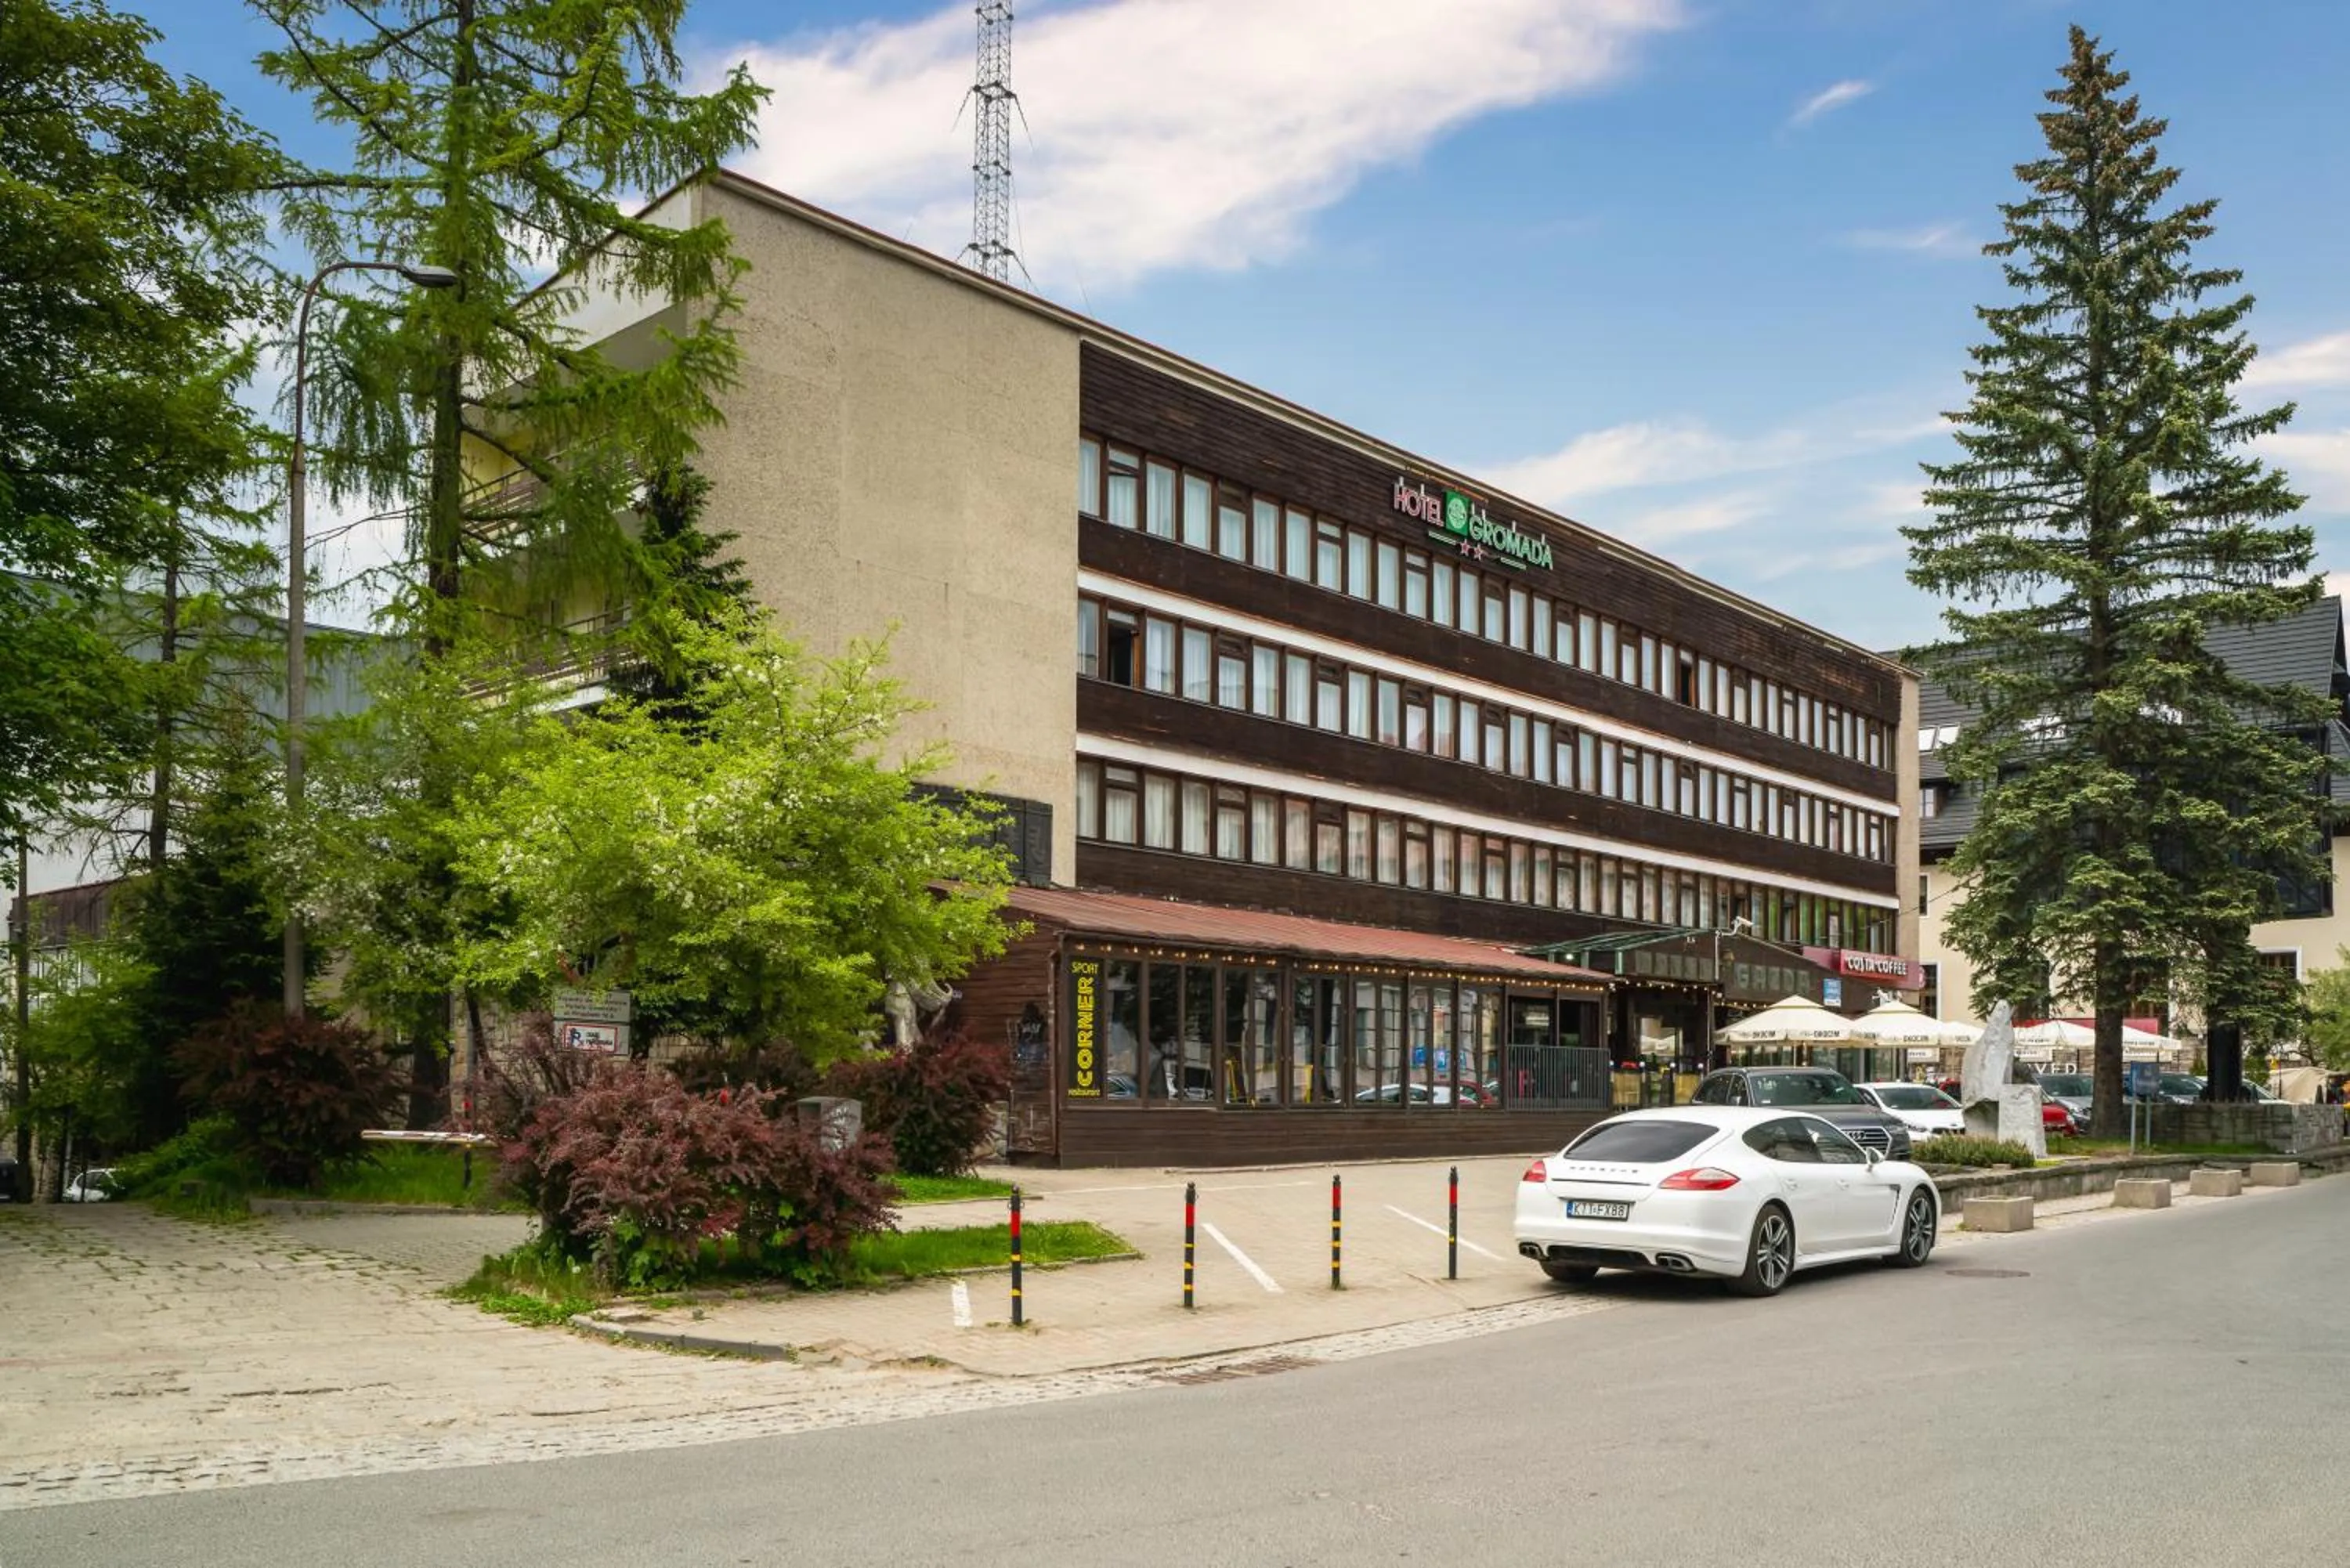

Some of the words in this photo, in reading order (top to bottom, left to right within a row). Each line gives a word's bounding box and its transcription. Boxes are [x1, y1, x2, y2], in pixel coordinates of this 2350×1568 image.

[1394, 482, 1444, 527] HOTEL
[1469, 514, 1554, 571] GROMADA
[1072, 961, 1099, 975] SPORT
[1846, 955, 1875, 973] COSTA
[1876, 959, 1907, 976] COFFEE
[1077, 977, 1094, 1087] CORNER
